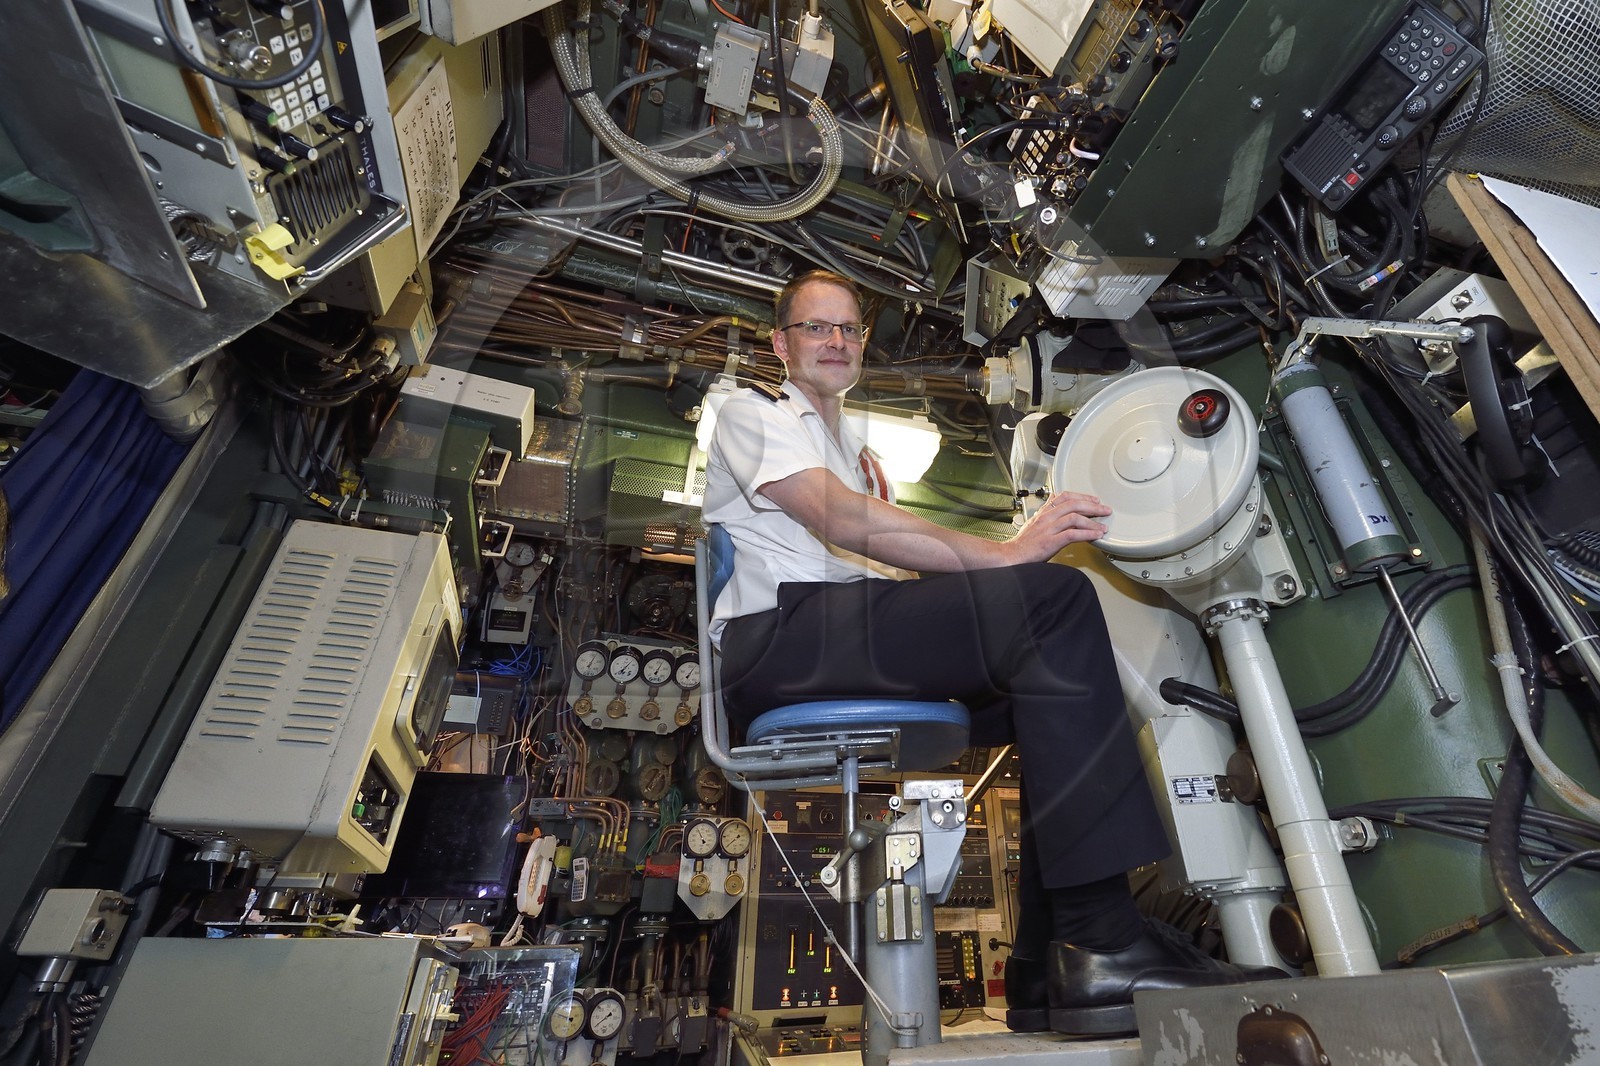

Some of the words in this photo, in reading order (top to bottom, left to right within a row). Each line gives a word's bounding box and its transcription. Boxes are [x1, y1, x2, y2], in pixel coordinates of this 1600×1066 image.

[1419, 71, 1428, 80] DW
[411, 116, 417, 128] 30
[445, 101, 455, 144] HEURE
[402, 124, 409, 135] 31
[360, 138, 376, 189] THALES
